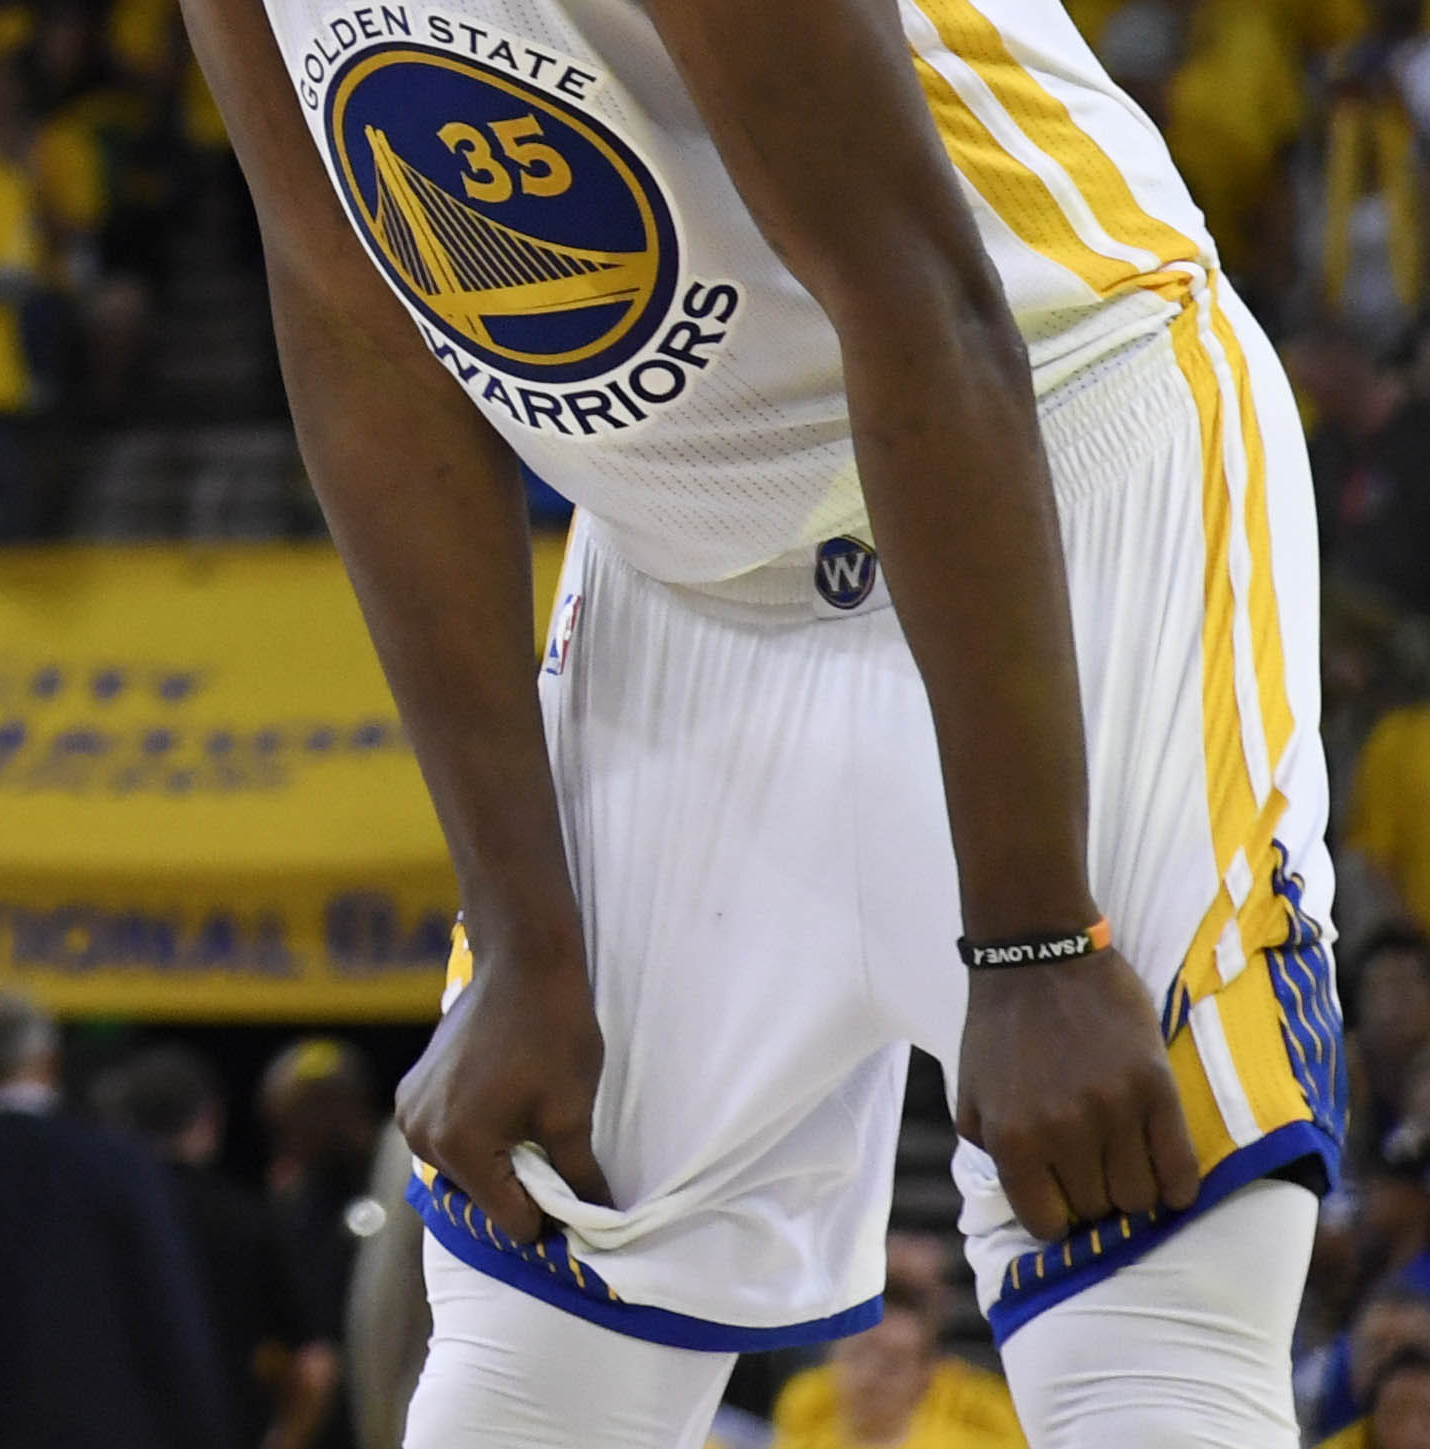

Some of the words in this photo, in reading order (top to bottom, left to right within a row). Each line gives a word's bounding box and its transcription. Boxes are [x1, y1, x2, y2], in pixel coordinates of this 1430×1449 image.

[300, 4, 411, 112] GOLDEN
[428, 15, 597, 101] STATE
[436, 113, 573, 204] 35
[419, 280, 740, 437] WARRIORS
[822, 552, 866, 592] W
[986, 944, 1036, 964] LOVE
[1039, 938, 1075, 960] SAY
